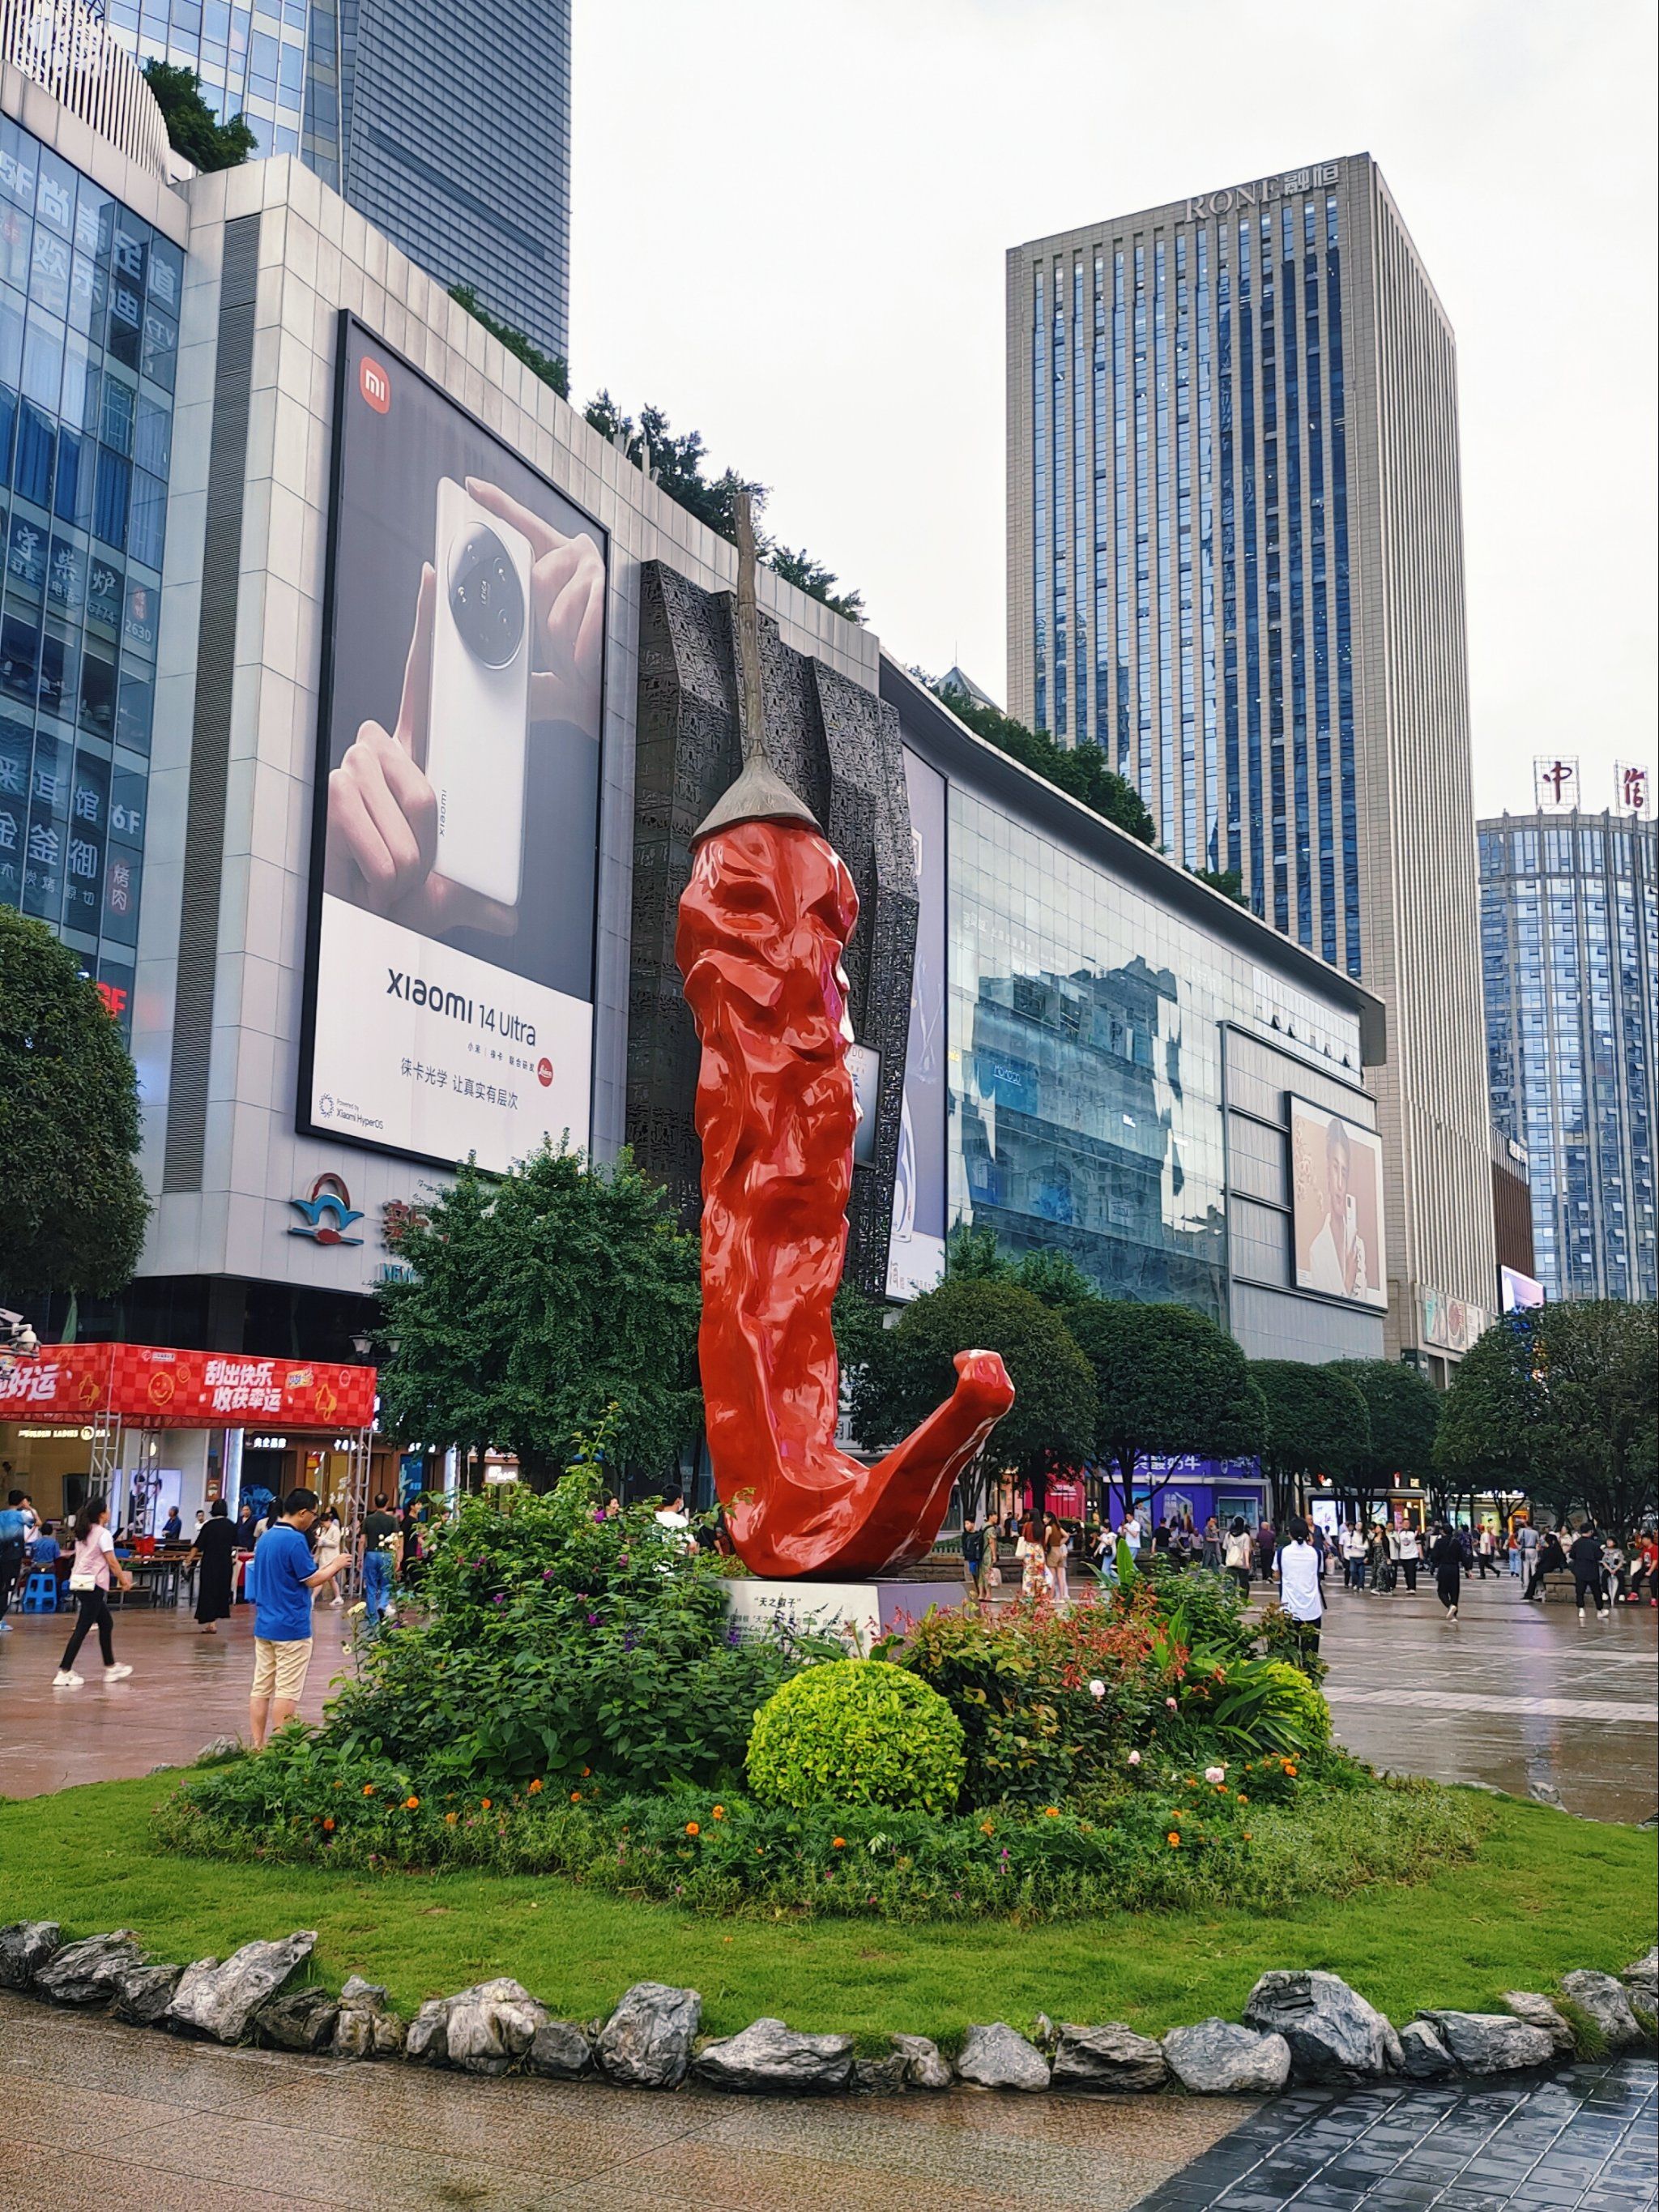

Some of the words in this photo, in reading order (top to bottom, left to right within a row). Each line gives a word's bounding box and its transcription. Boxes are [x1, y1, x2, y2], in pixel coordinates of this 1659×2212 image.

[1184, 177, 1282, 224] RONE
[125, 619, 152, 643] 2630
[111, 804, 141, 835] 6F
[479, 1005, 495, 1032] 14
[500, 1010, 536, 1047] Ultra
[400, 1057, 448, 1088] 徕卡光学
[452, 1074, 518, 1110] 让真实有层次
[336, 1108, 356, 1122] Xiaomi
[356, 1114, 384, 1129] HyperOS
[204, 1360, 275, 1386] 刮出快乐
[211, 1387, 283, 1412] 收获幸运
